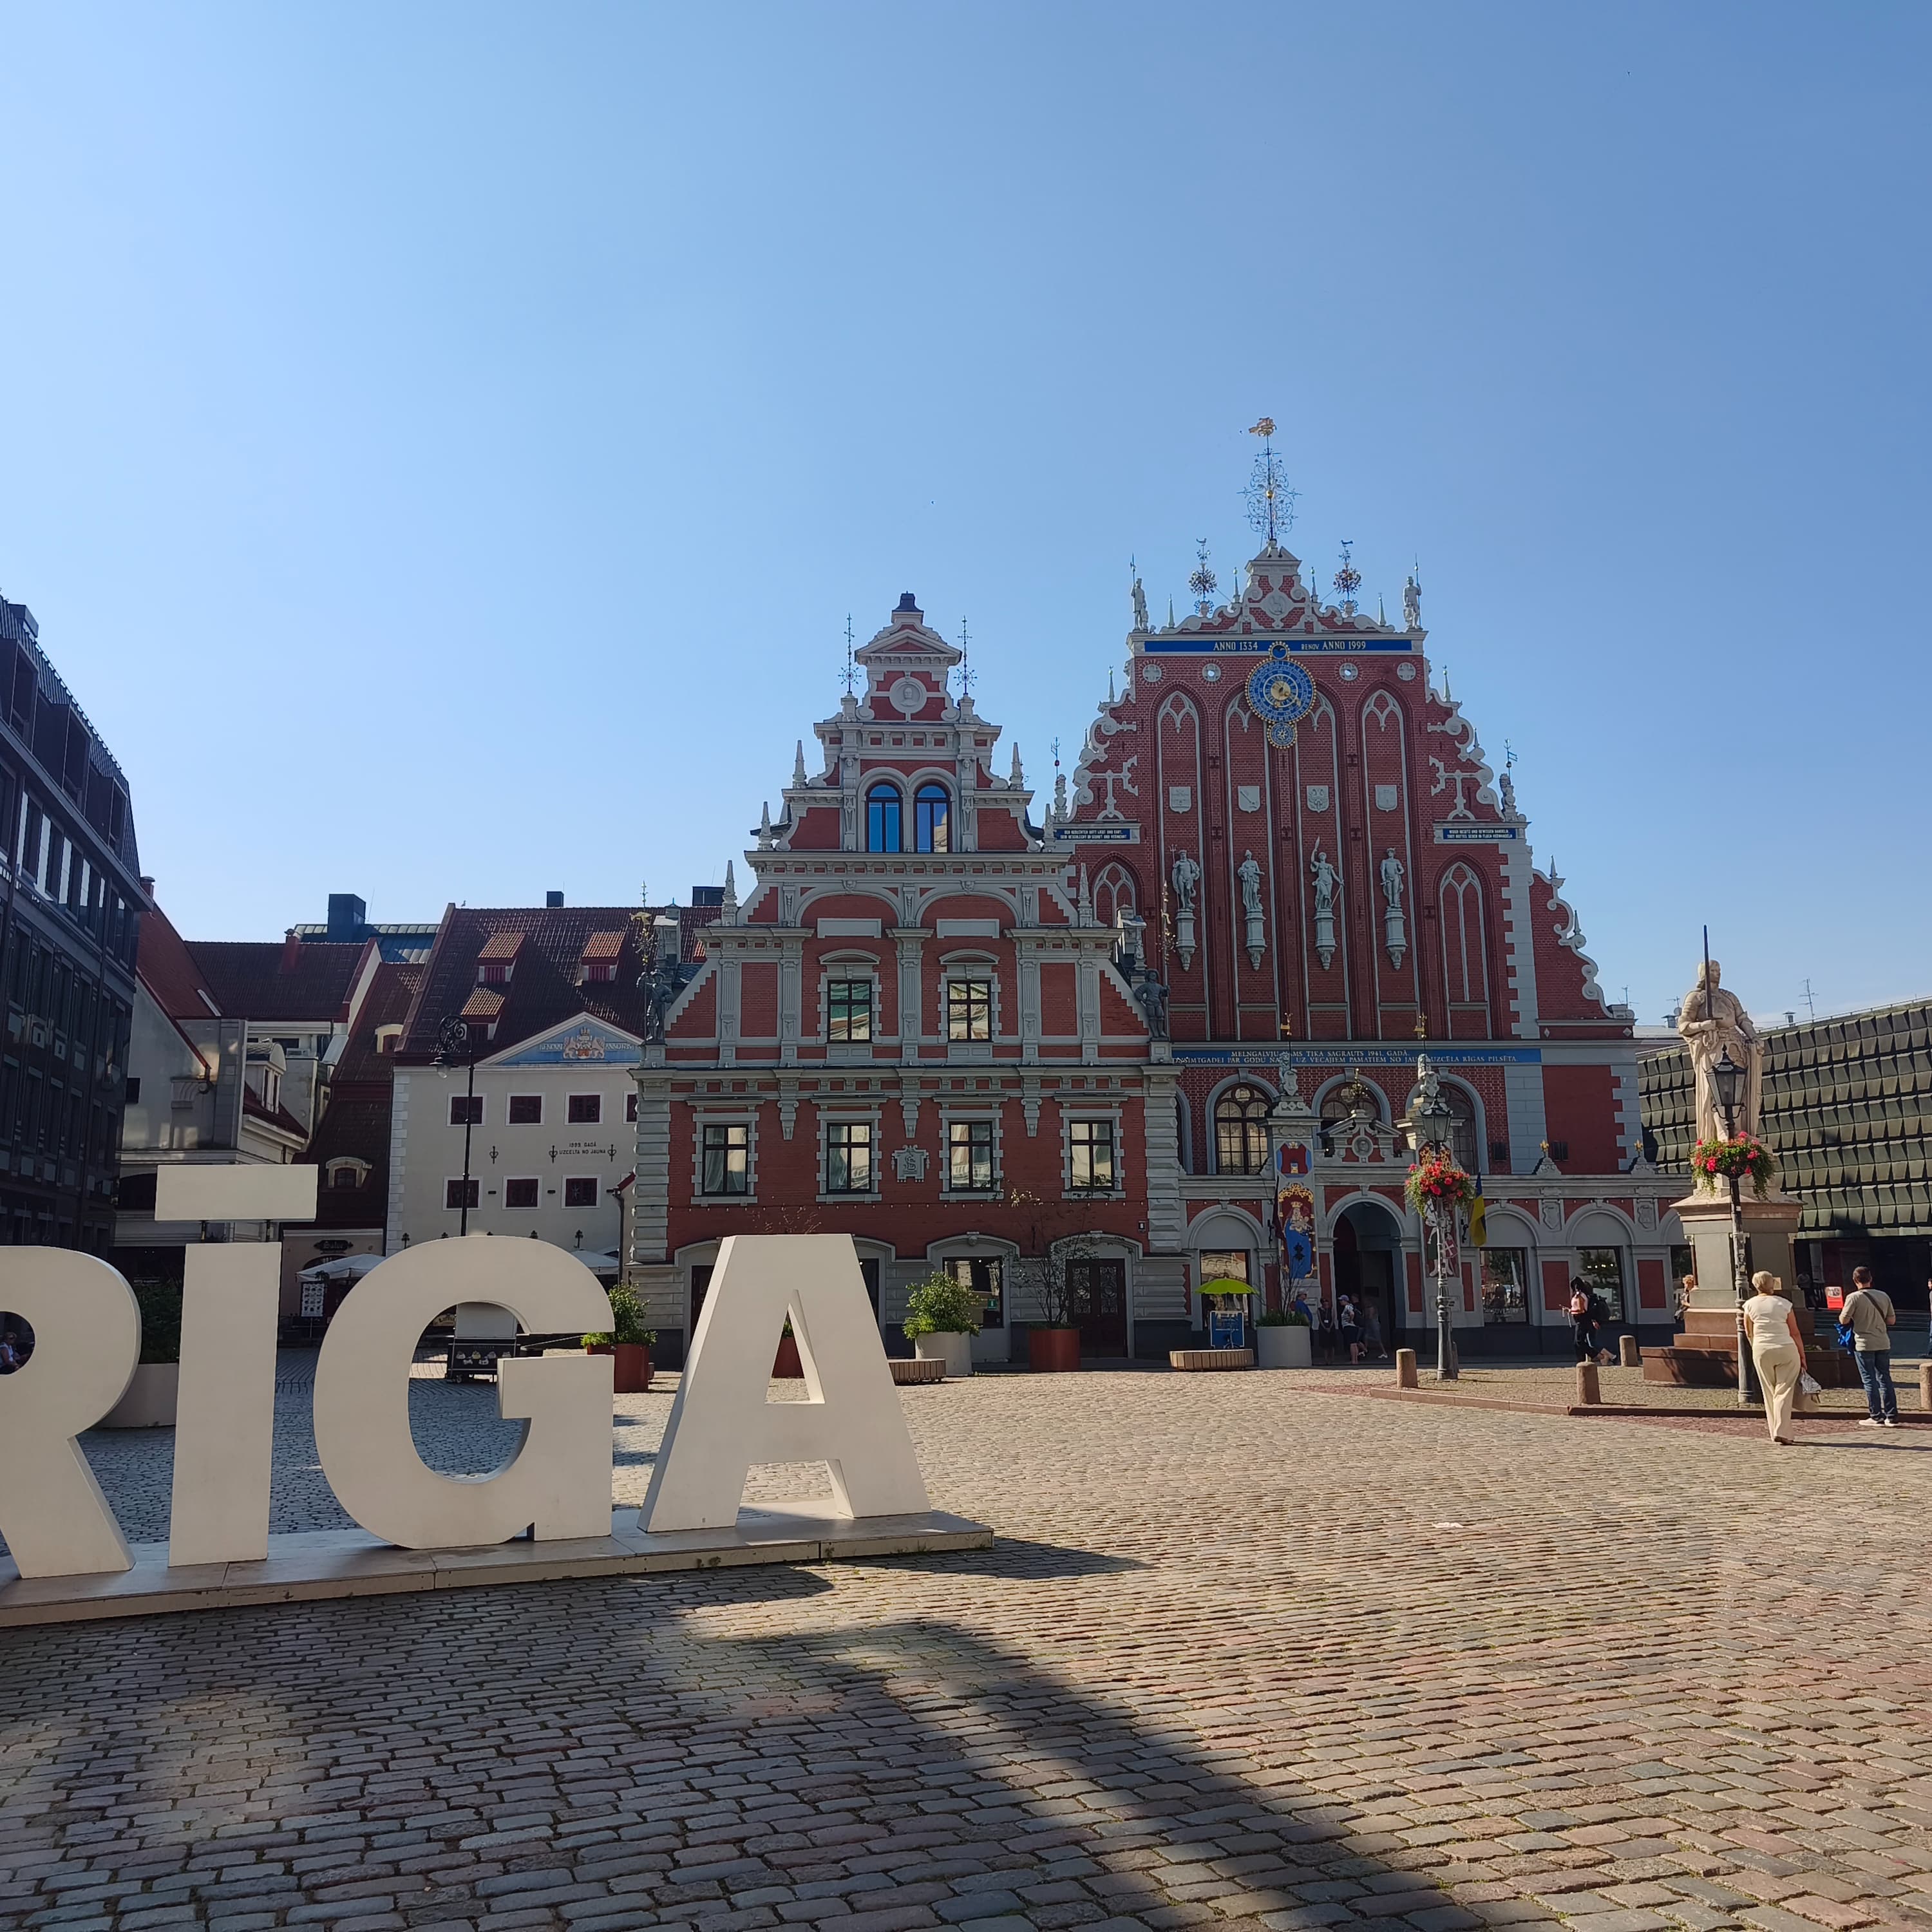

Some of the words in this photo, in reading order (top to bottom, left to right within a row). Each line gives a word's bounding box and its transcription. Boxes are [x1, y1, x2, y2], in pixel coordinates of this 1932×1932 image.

[1213, 641, 1236, 651] ANNO
[1239, 641, 1258, 650] 1334
[1322, 641, 1345, 650] ANNO
[1348, 641, 1366, 649] 1999
